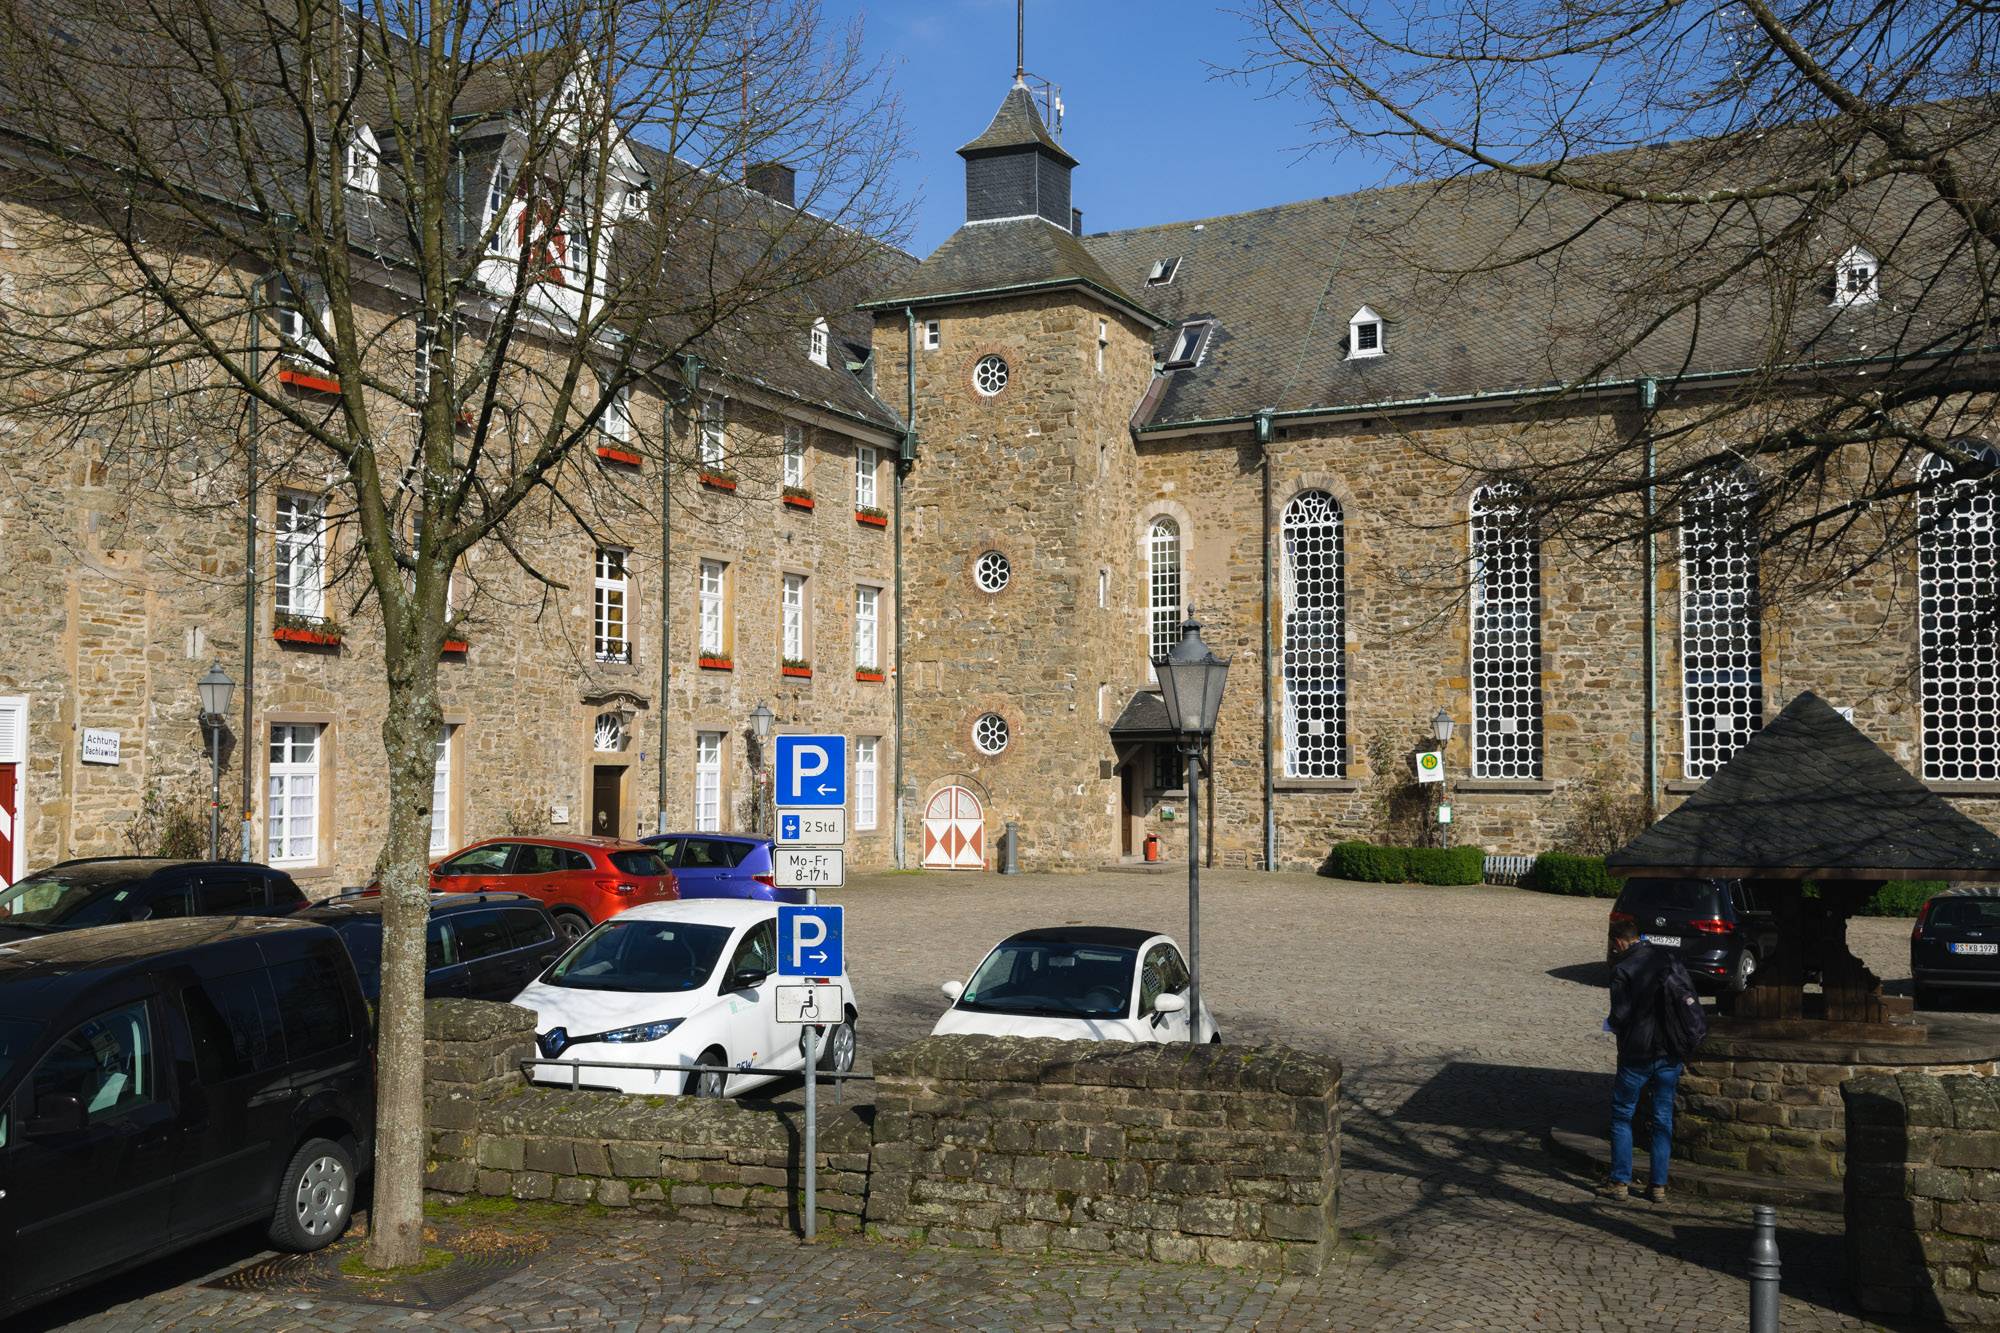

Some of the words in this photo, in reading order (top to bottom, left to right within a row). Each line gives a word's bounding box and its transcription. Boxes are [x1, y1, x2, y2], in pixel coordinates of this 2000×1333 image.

[88, 734, 118, 749] Achtung
[85, 745, 118, 758] Dachlawine
[792, 744, 829, 797] P
[804, 821, 812, 833] 2
[815, 821, 839, 833] Std.
[789, 855, 829, 866] Mo-Fr
[795, 869, 820, 881] 8-17
[823, 869, 829, 881] h
[792, 914, 828, 968] P
